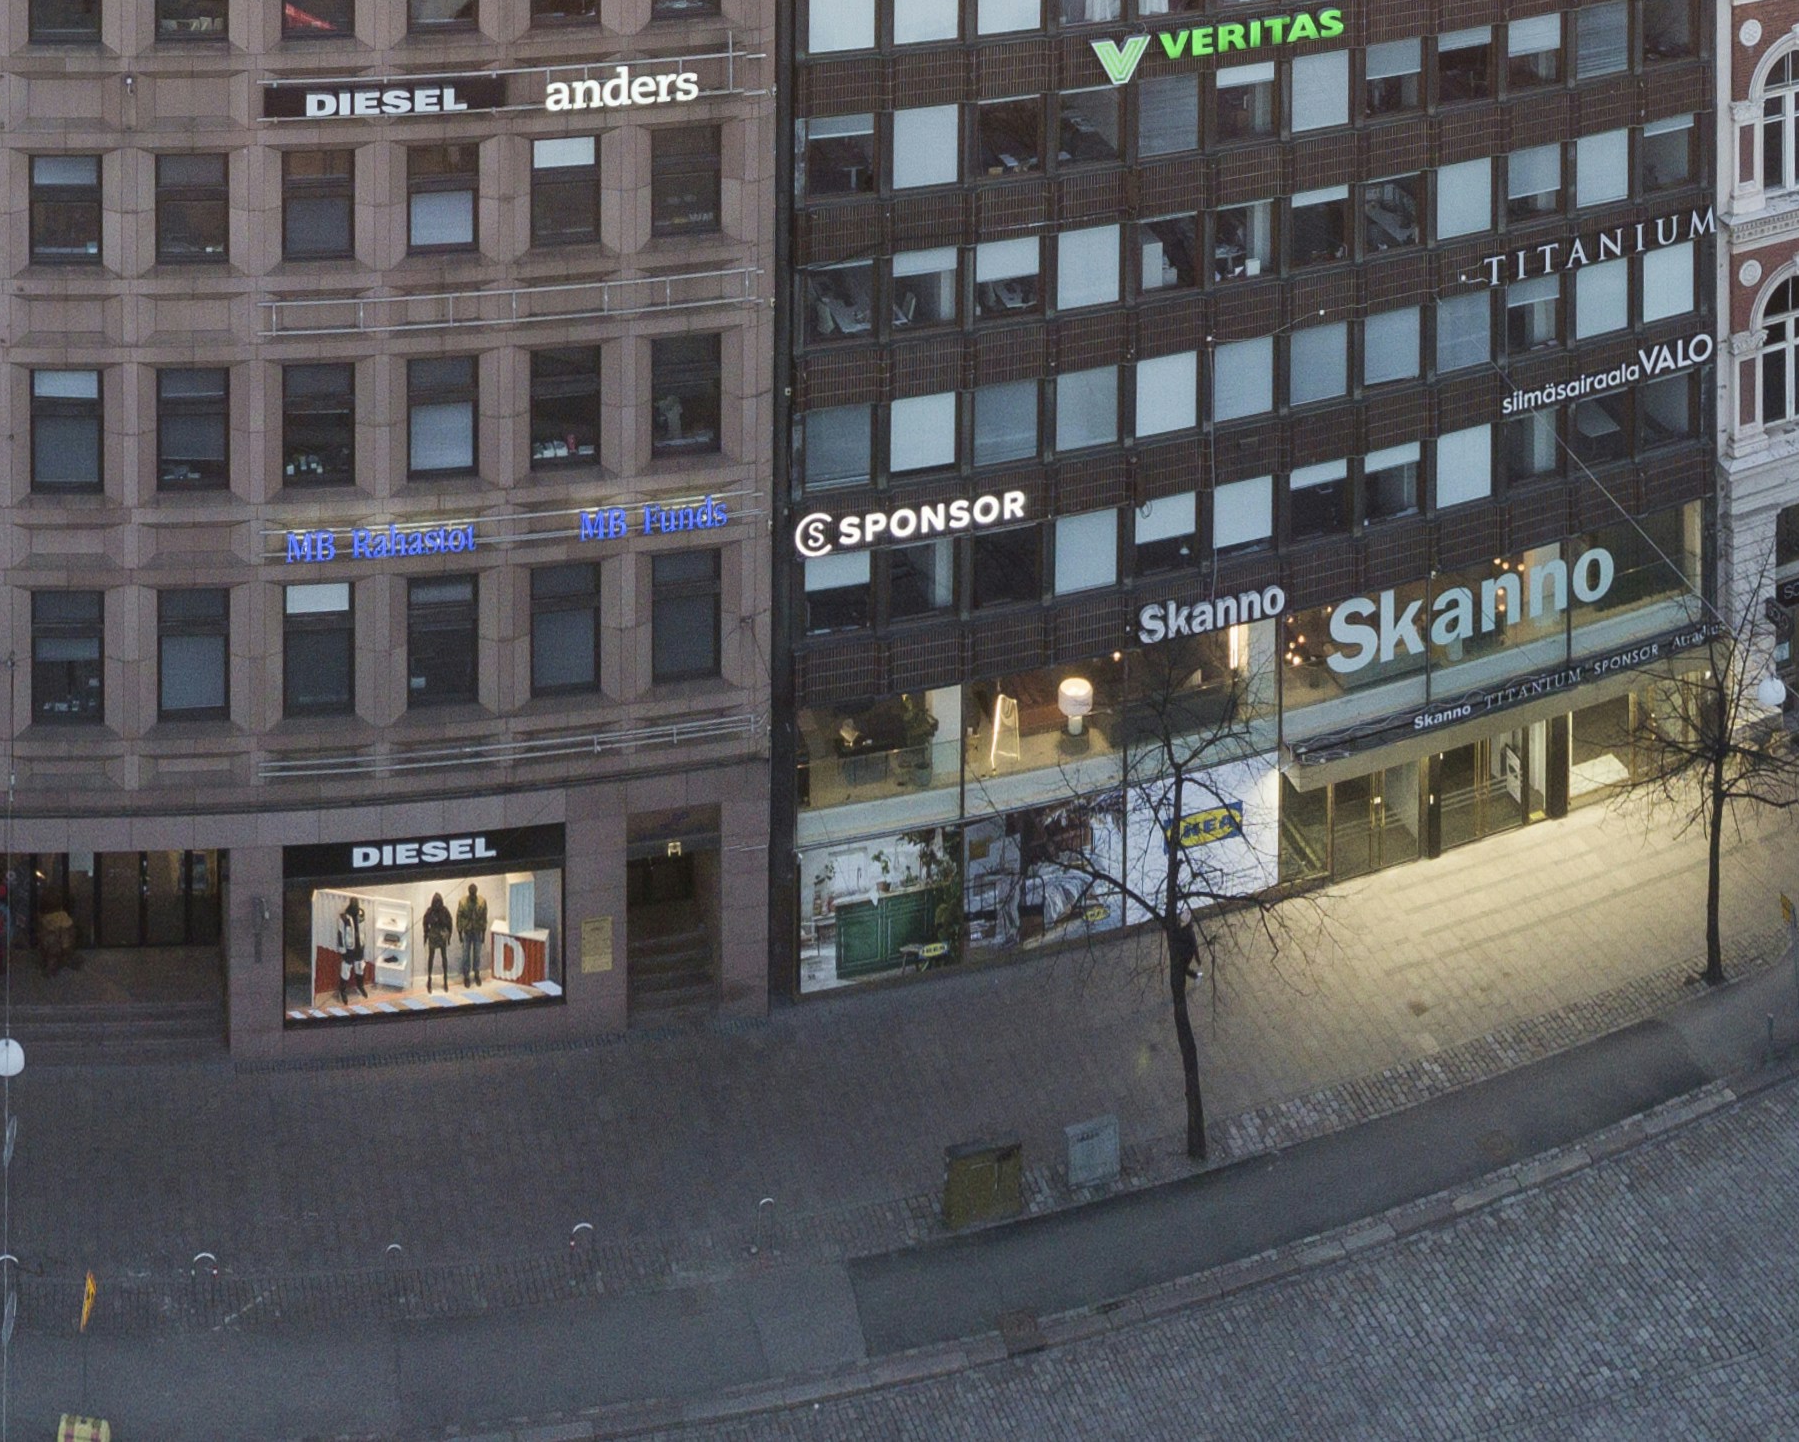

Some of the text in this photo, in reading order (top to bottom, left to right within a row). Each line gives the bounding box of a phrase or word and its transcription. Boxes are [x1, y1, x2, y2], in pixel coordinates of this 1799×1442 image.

[1159, 7, 1345, 59] VERITAS
[306, 86, 468, 118] DIESEL
[545, 66, 700, 112] anders
[1483, 205, 1717, 286] TITANIUM
[1502, 333, 1713, 414] silmäsairaala VALO
[285, 524, 477, 563] MB Rahastot
[579, 494, 729, 541] MB Funds
[839, 490, 1026, 545] SPONSOR
[1138, 584, 1286, 645] Skanno
[1326, 547, 1616, 674] Skanno
[1413, 703, 1472, 730] Skanno
[1483, 667, 1585, 710] TITANIUM
[1593, 642, 1660, 675] SPONSOR
[352, 836, 497, 868] DIESEL
